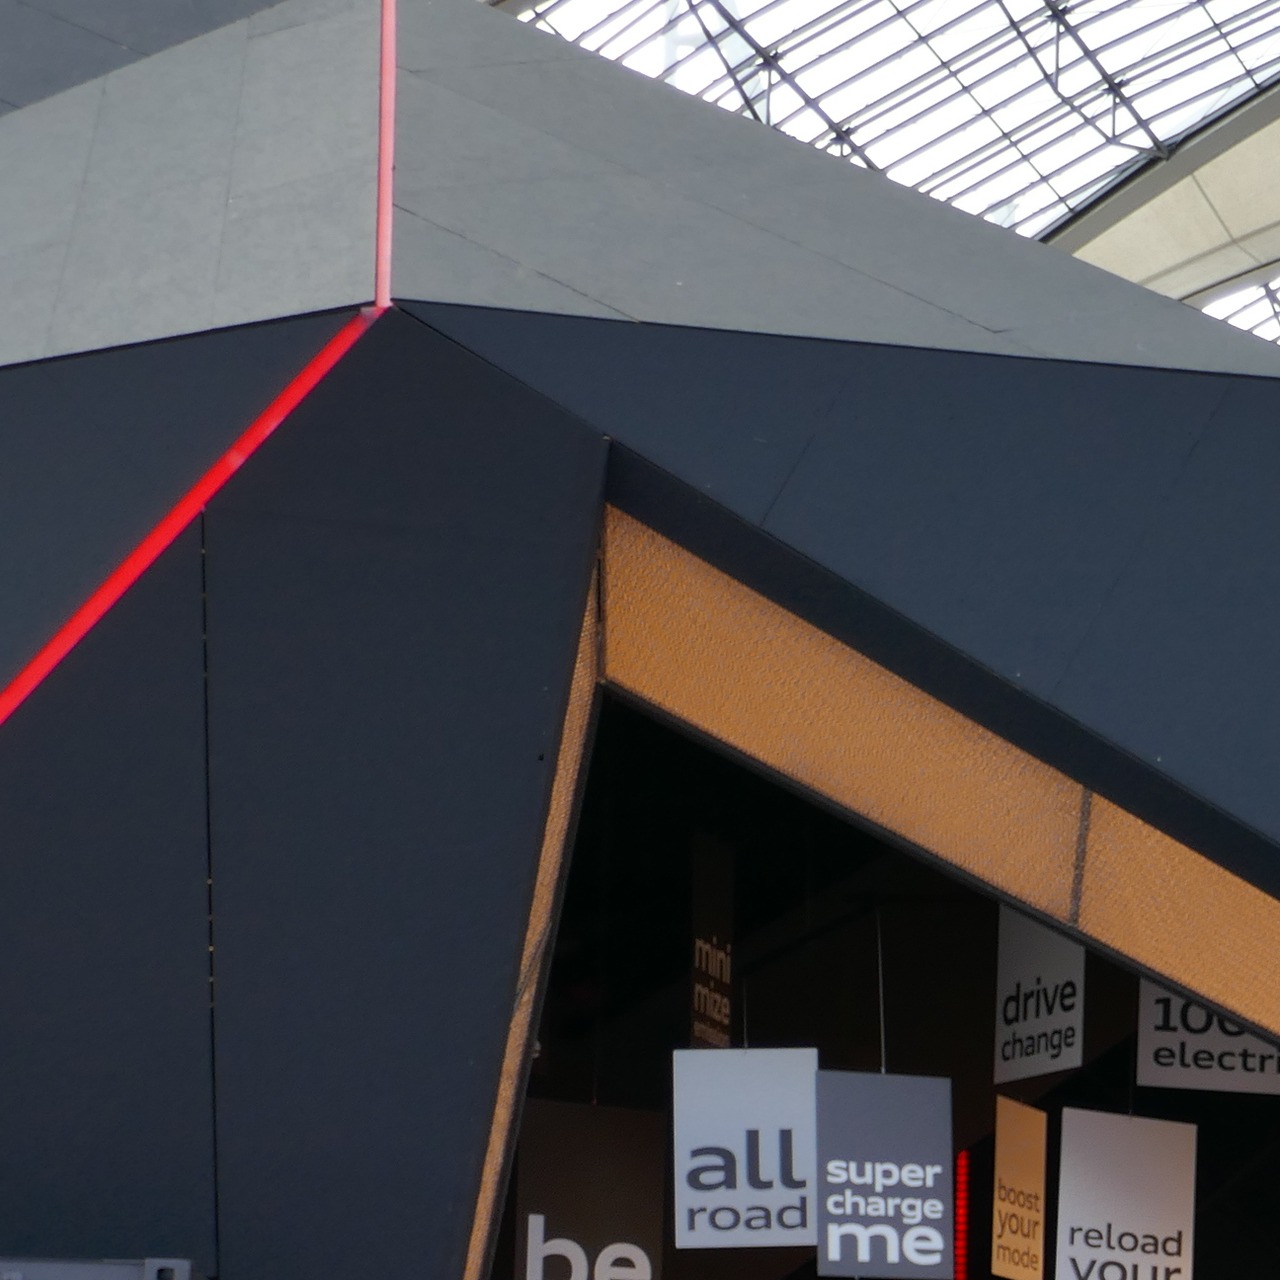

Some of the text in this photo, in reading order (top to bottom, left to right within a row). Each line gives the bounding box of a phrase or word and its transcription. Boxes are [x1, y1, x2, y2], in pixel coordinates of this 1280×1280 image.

[1002, 977, 1077, 1026] drive
[1001, 1027, 1076, 1062] change
[686, 1128, 807, 1191] all
[825, 1158, 942, 1193] super
[686, 1196, 808, 1232] road
[825, 1190, 944, 1225] charge
[997, 1182, 1041, 1214] boost
[997, 1209, 1040, 1241] your
[1068, 1222, 1183, 1256] reload
[826, 1221, 944, 1266] me
[996, 1241, 1039, 1272] mode
